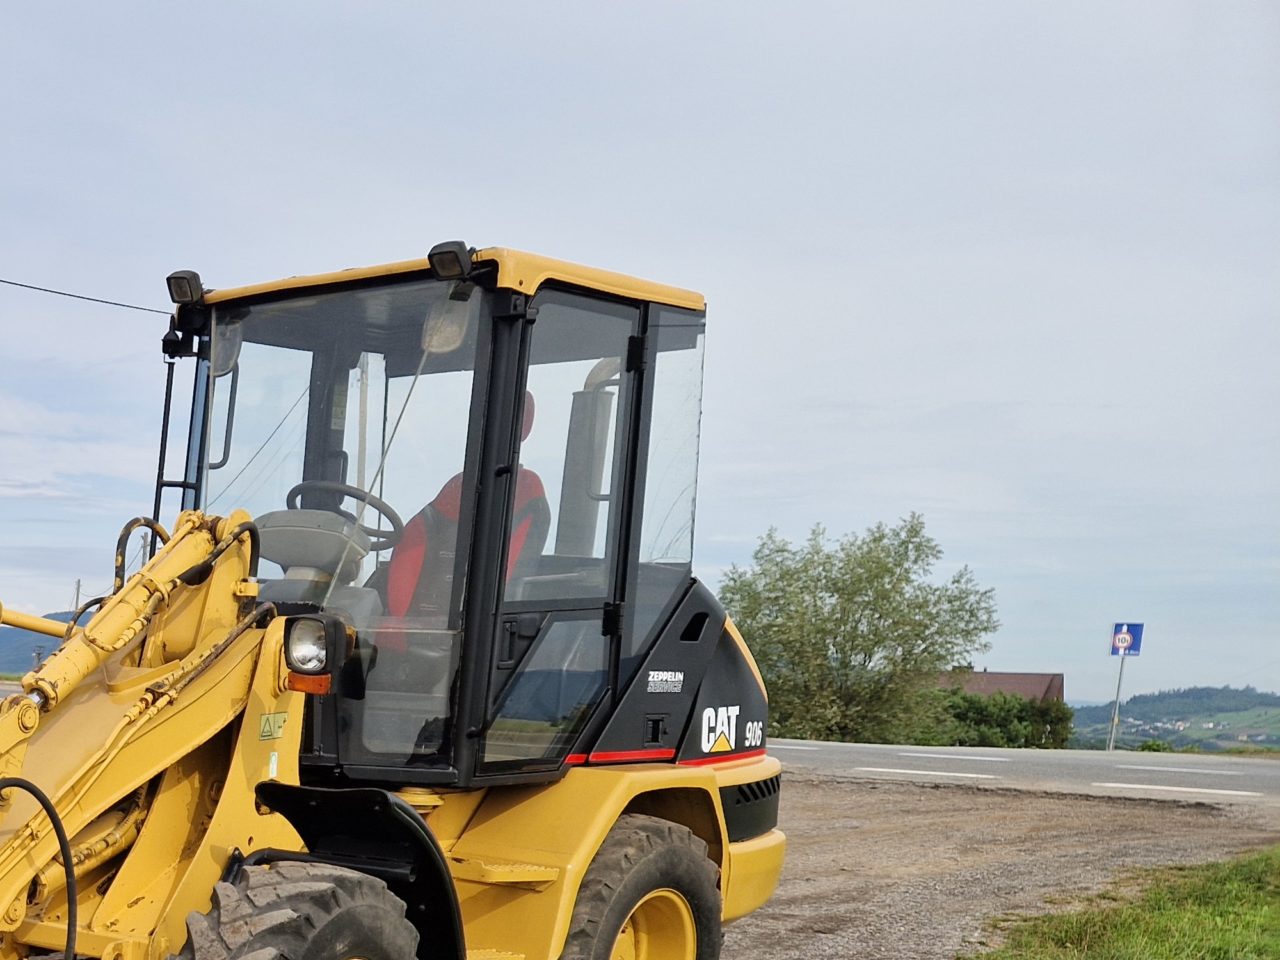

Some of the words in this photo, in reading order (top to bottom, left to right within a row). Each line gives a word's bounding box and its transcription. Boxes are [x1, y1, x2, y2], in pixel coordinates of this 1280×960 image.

[648, 671, 684, 681] ZEPPELIN
[647, 681, 682, 692] SERVICE
[701, 706, 740, 753] CAT
[745, 721, 763, 747] 906
